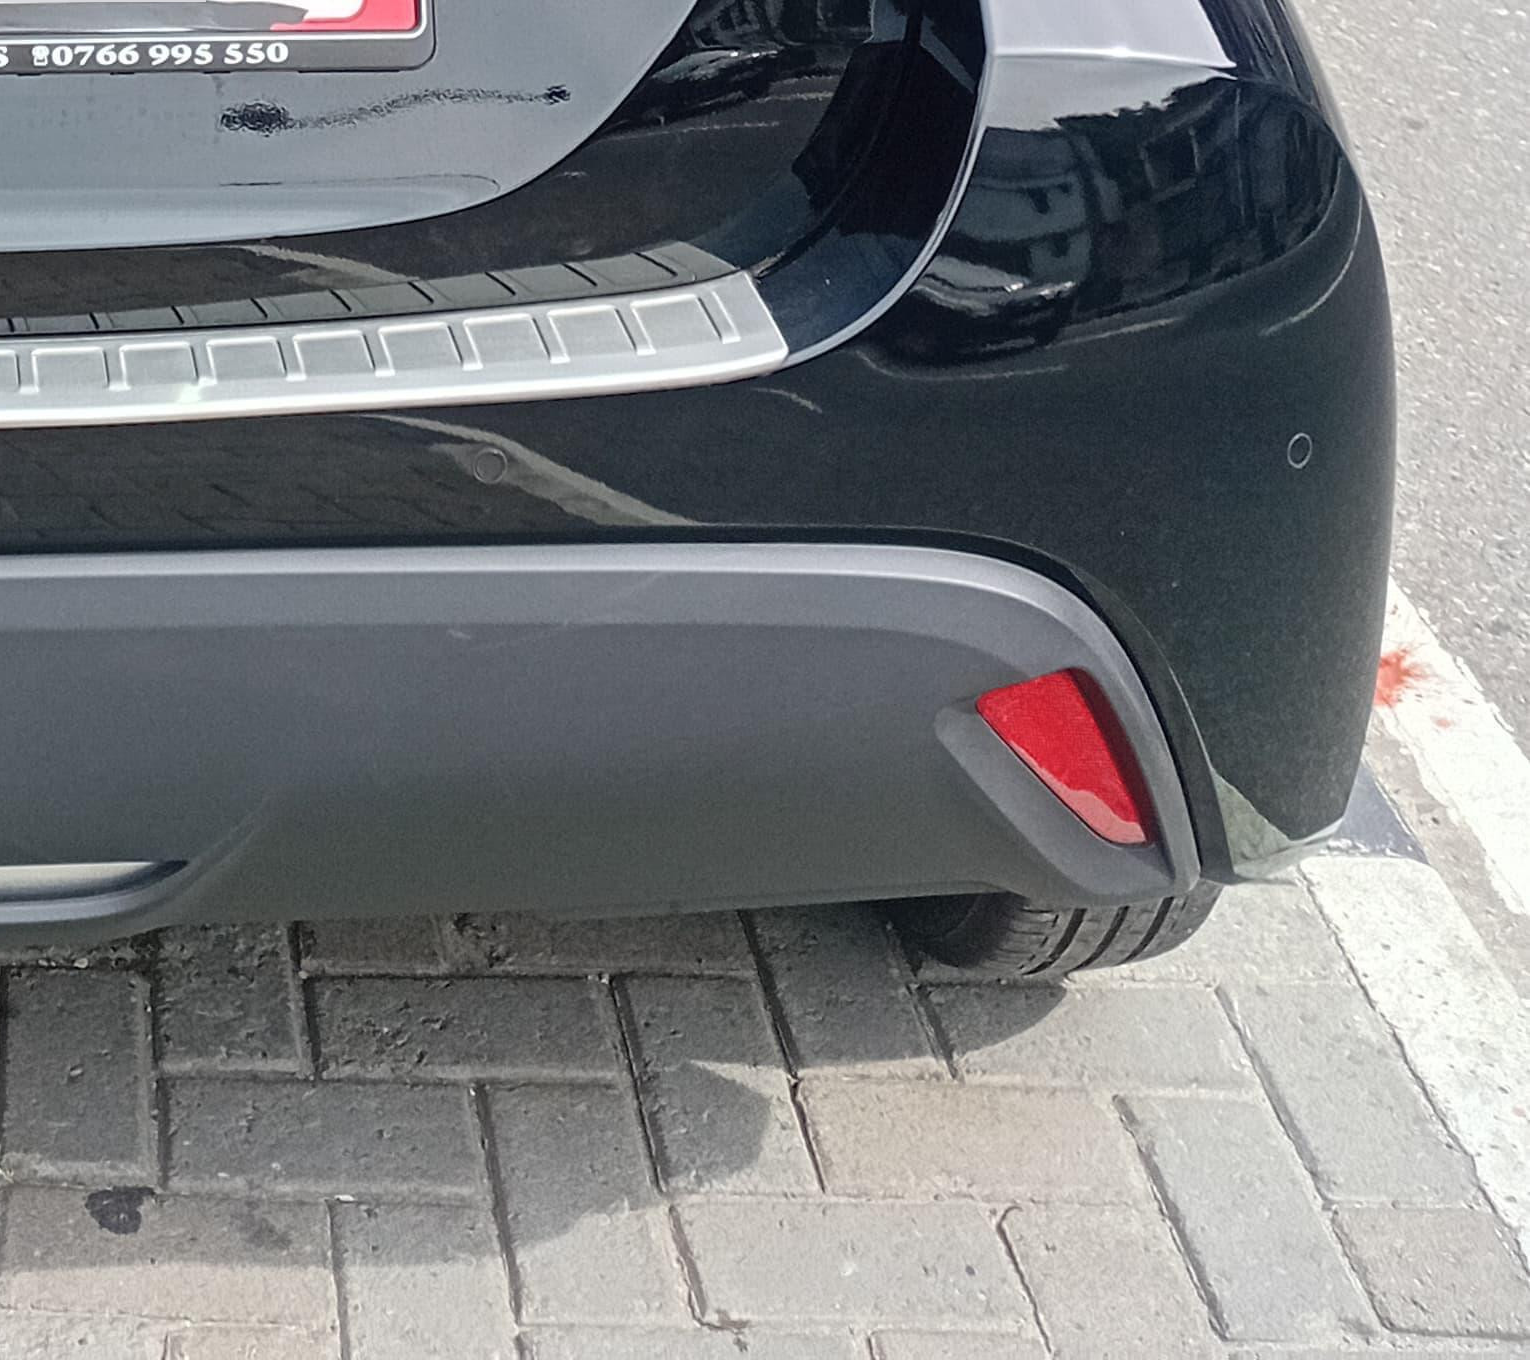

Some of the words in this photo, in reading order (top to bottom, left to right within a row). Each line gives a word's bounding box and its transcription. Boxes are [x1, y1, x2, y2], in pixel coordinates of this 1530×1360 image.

[51, 43, 140, 67] 0766
[148, 43, 214, 65] 995
[223, 42, 290, 65] 550
